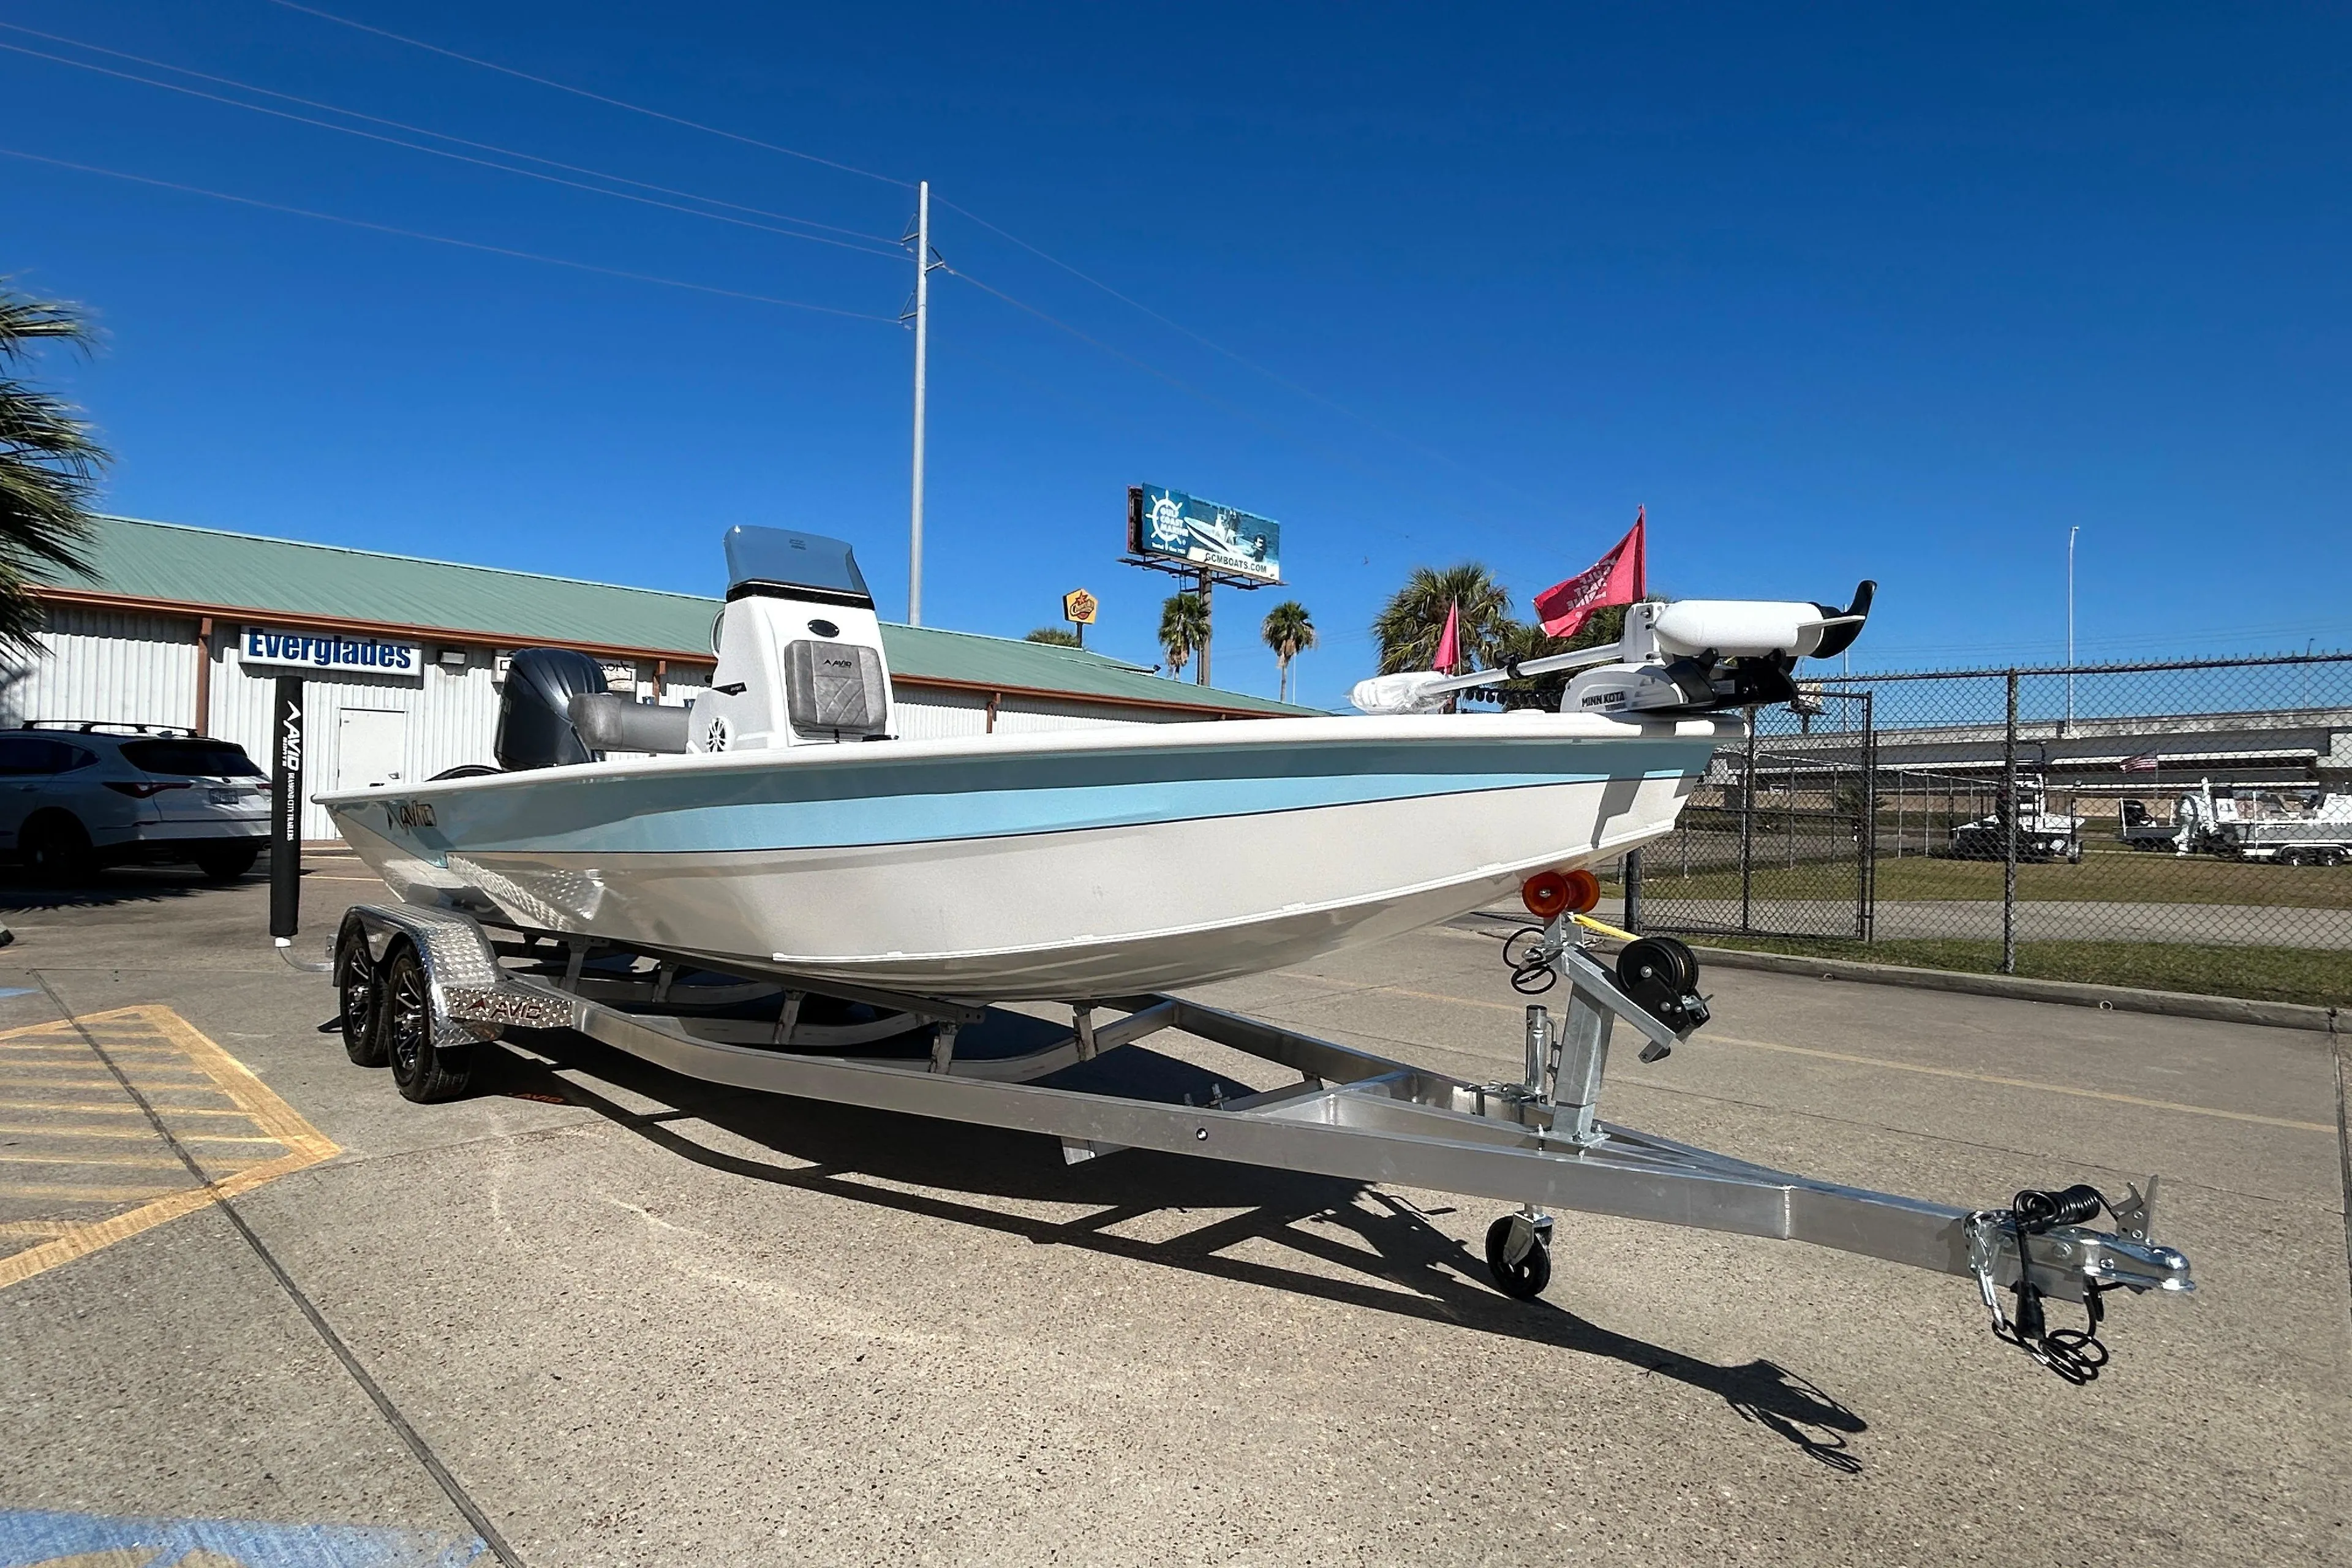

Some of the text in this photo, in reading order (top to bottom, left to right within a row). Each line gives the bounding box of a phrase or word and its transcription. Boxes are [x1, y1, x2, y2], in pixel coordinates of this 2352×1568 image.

[1205, 552, 1267, 573] GCMBOATS.COM
[249, 628, 411, 669] Everglades
[1581, 695, 1602, 707] MINN
[1604, 690, 1627, 703] KOTA
[283, 720, 301, 771] AVID
[490, 1001, 543, 1020] AVID
